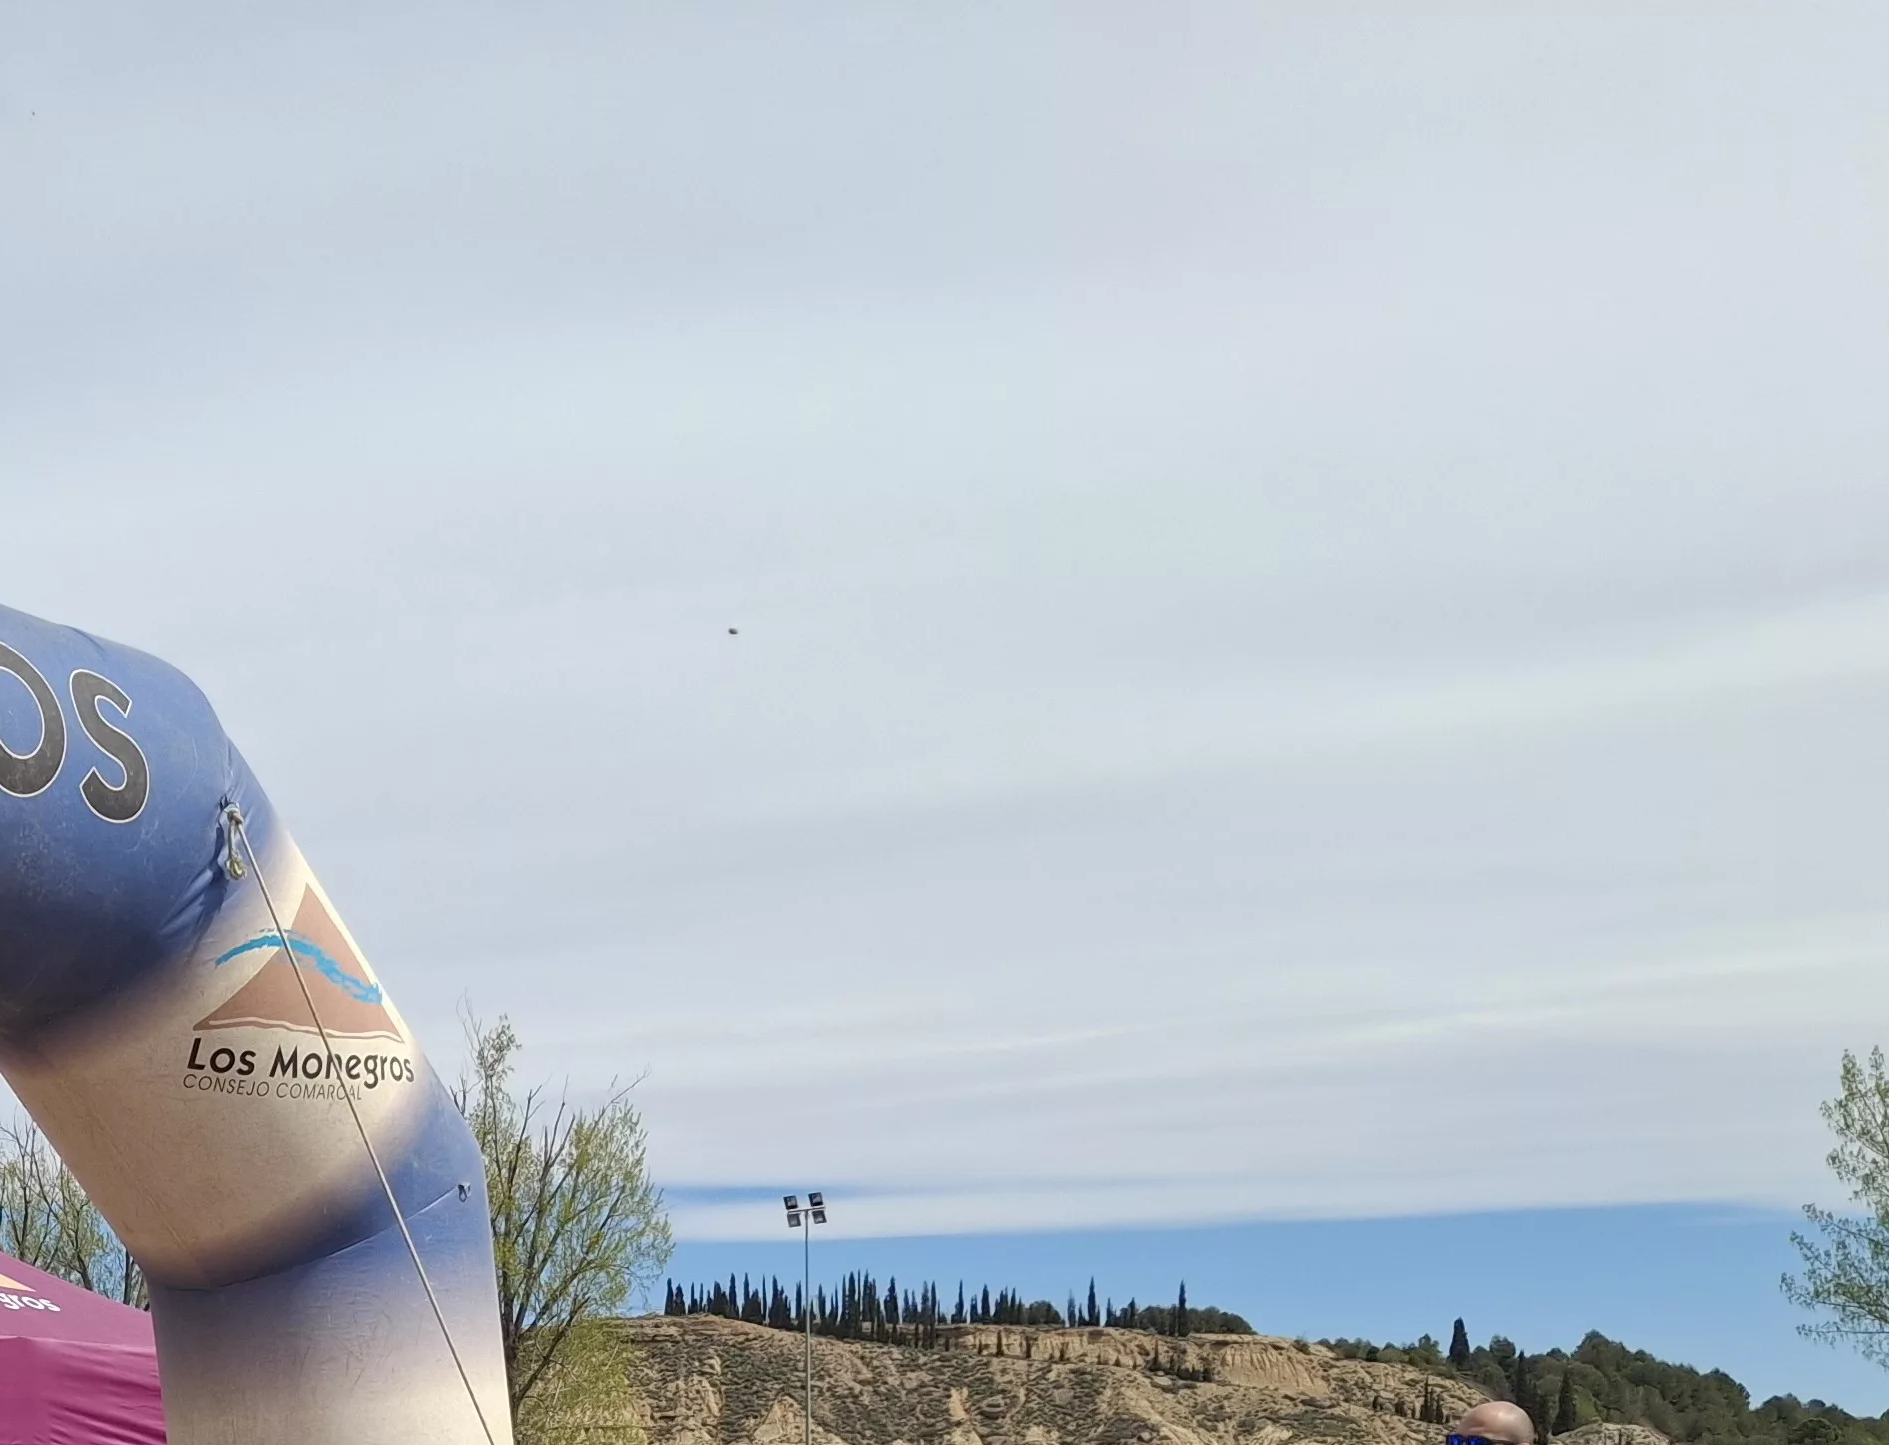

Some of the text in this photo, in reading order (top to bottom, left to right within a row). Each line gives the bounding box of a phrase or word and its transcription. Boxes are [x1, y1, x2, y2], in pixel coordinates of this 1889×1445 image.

[186, 1037, 415, 1090] Los Monegros
[182, 1073, 363, 1101] CONSEJO COMARCAL
